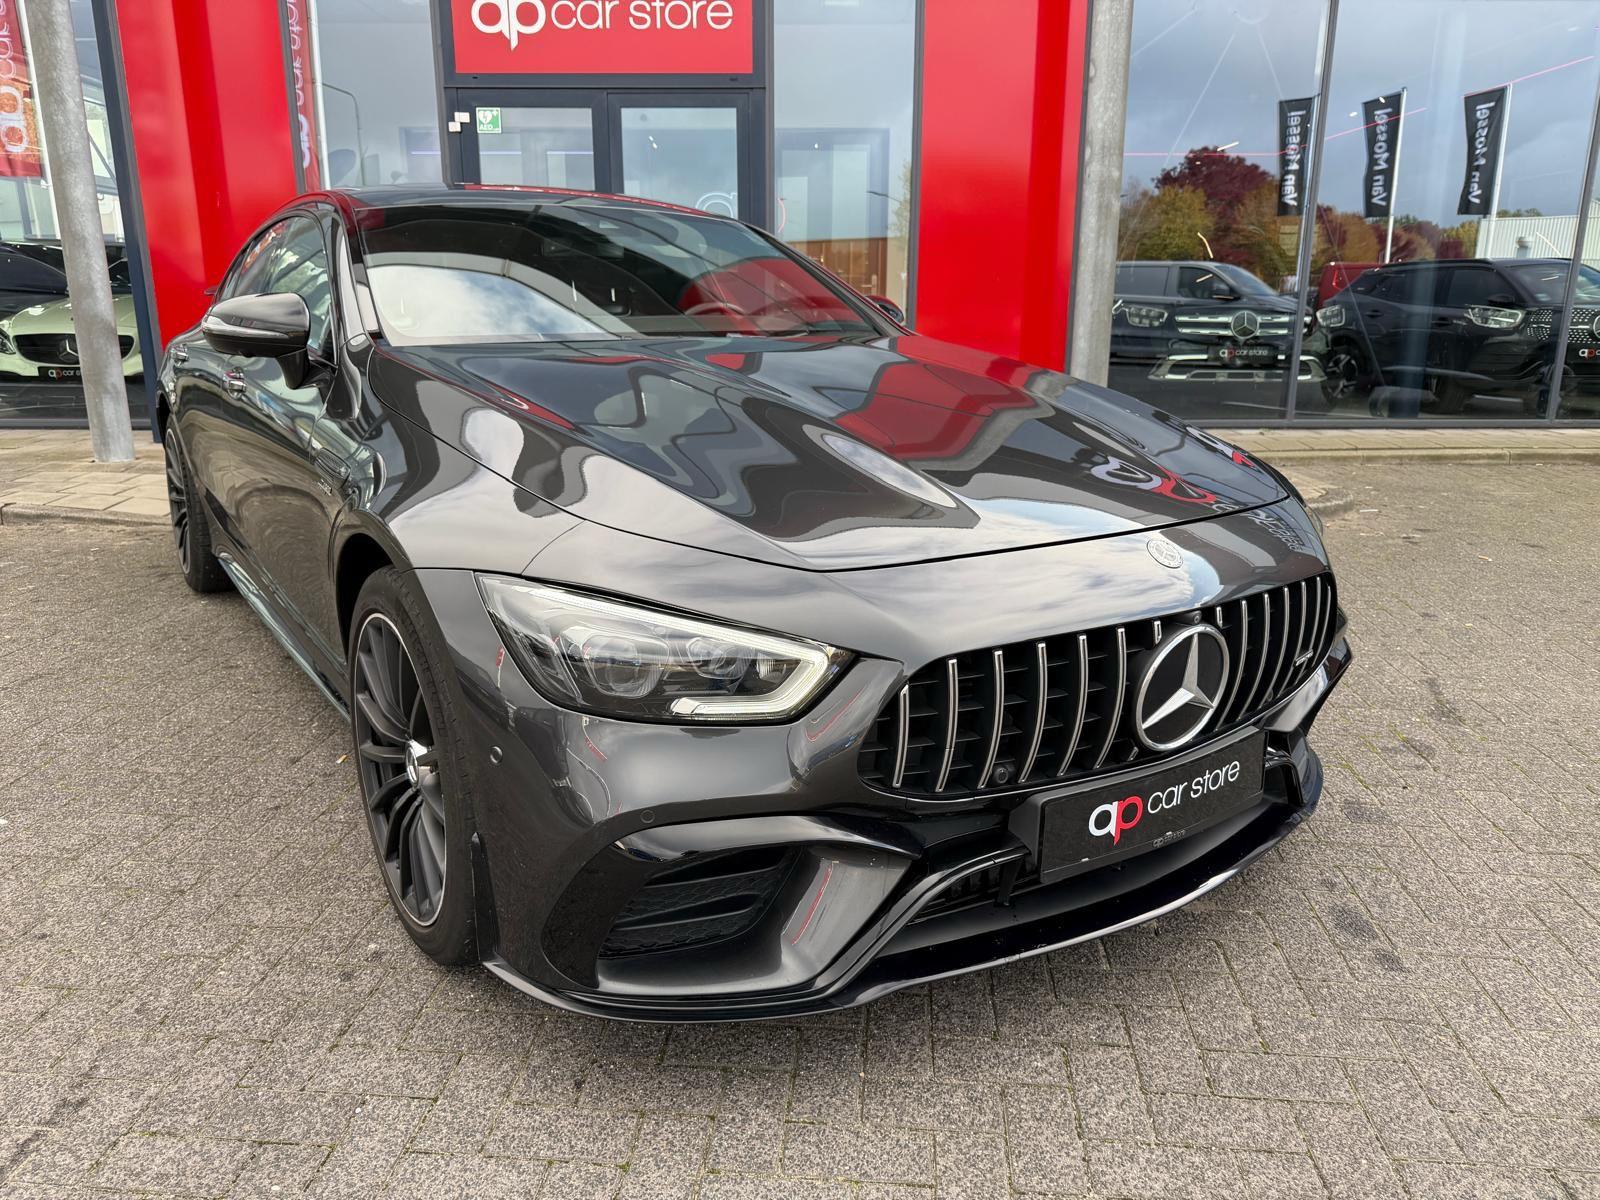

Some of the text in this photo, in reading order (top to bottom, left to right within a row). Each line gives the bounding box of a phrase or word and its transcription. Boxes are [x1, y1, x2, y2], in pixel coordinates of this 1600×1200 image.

[551, 0, 619, 29] car
[629, 0, 733, 29] store
[1147, 782, 1188, 814] car
[1190, 760, 1240, 798] store
